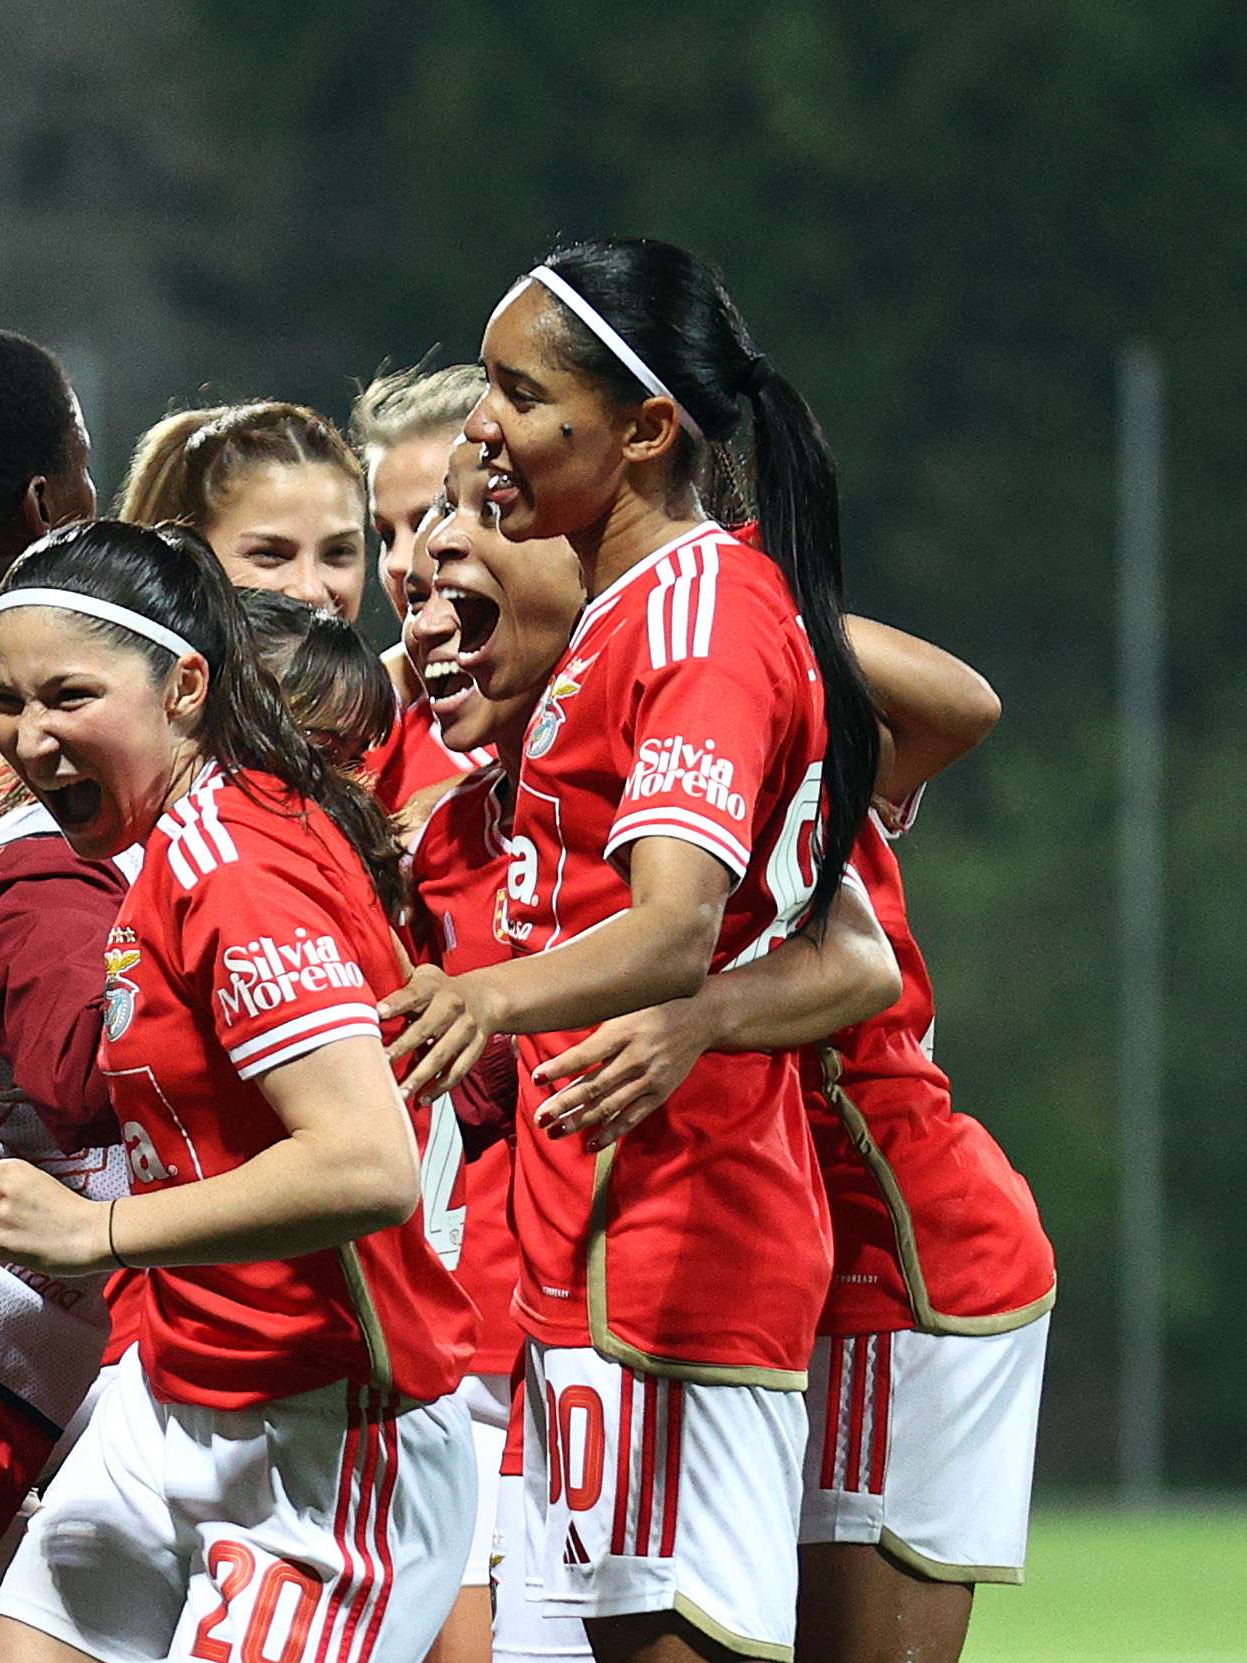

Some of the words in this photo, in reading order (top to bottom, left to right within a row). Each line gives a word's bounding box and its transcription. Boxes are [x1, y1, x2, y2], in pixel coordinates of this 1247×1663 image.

[623, 757, 746, 822] Moreno
[637, 735, 734, 788] Silvia
[223, 928, 343, 987] Silvia
[217, 960, 364, 1027] Moreno
[189, 1539, 323, 1663] 20
